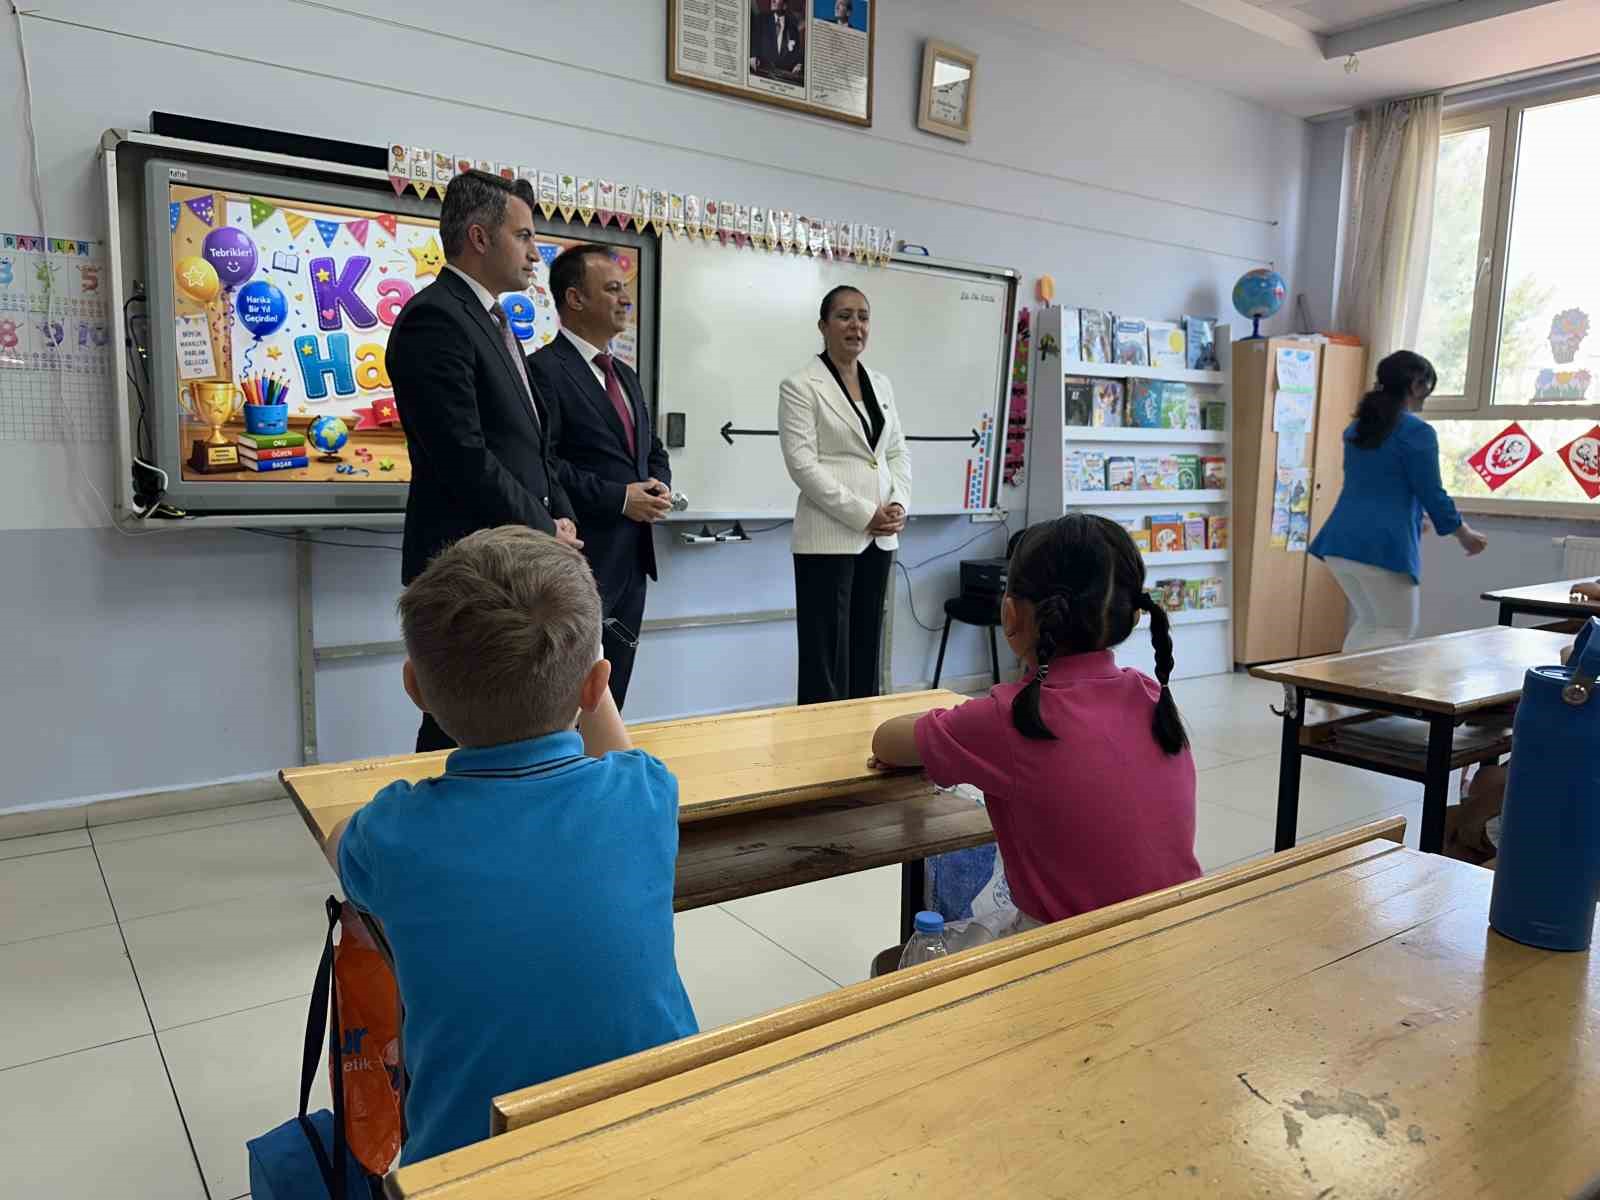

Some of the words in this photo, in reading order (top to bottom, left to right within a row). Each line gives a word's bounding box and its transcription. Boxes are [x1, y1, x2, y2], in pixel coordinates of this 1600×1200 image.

[415, 165, 428, 177] Bb
[419, 182, 425, 191] 2
[209, 248, 253, 257] Tebrikler!
[246, 296, 271, 304] Harika
[248, 305, 260, 313] Bir
[272, 439, 288, 447] OKU
